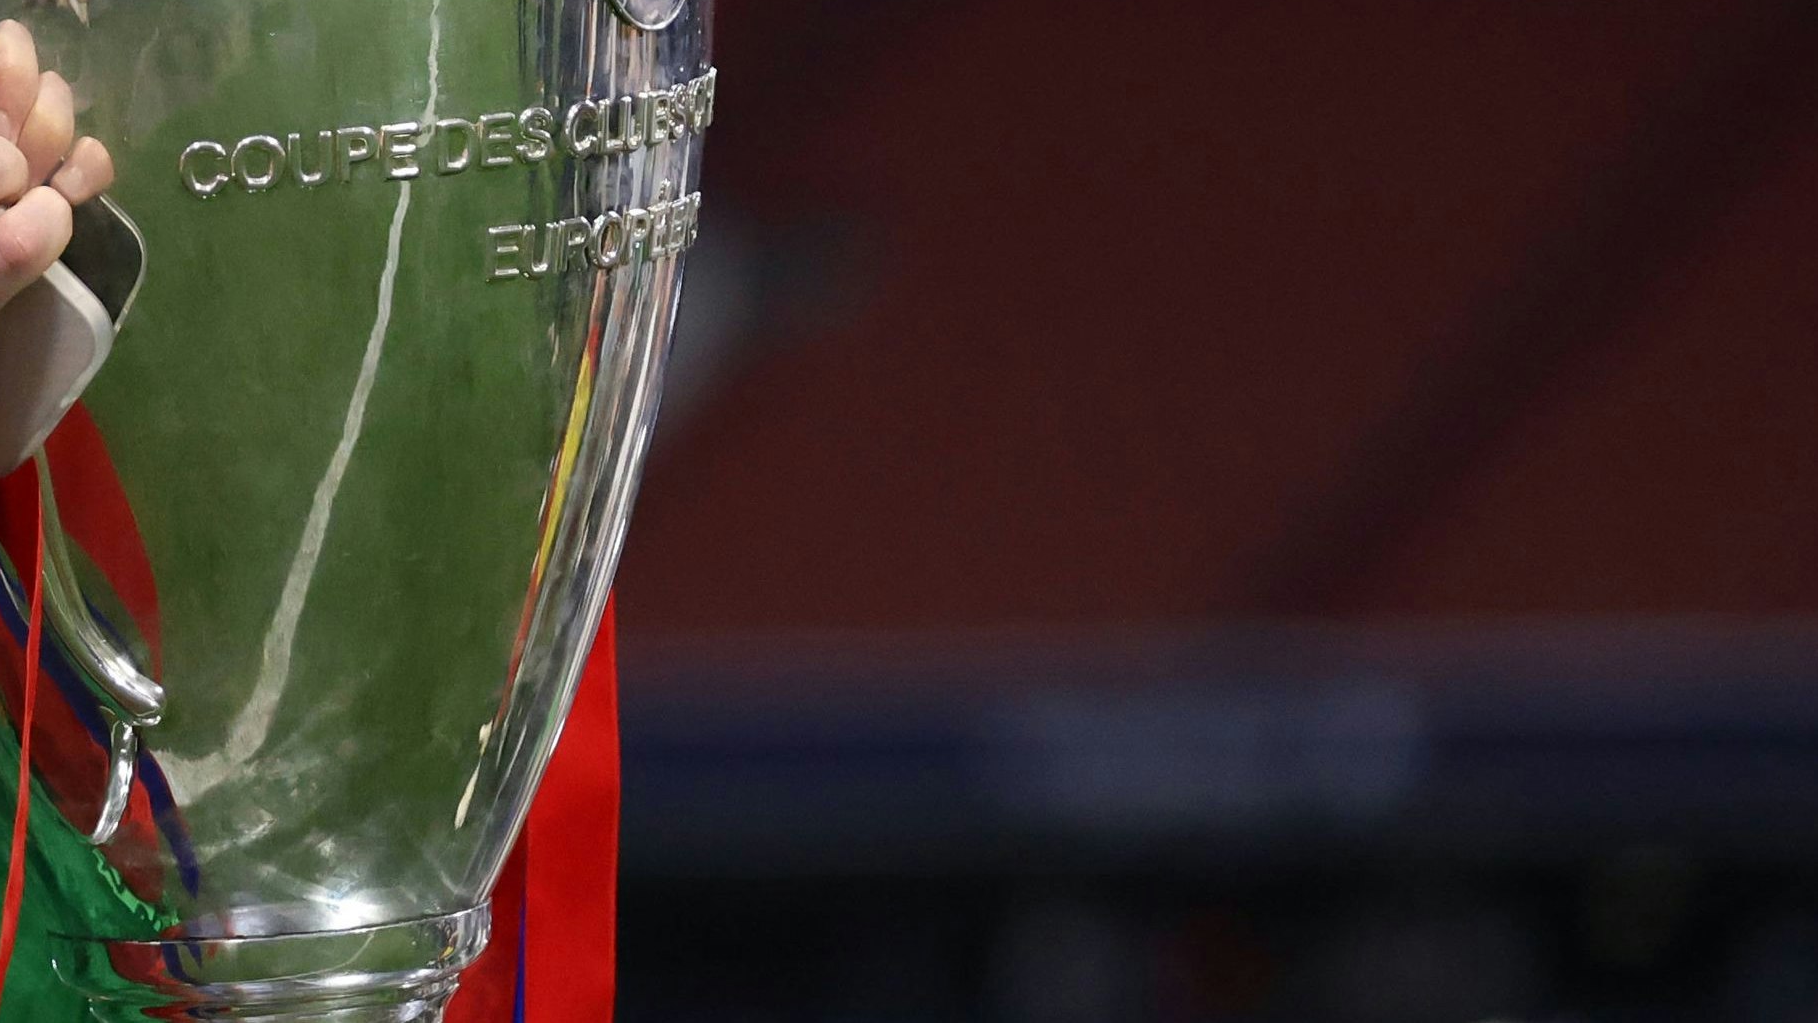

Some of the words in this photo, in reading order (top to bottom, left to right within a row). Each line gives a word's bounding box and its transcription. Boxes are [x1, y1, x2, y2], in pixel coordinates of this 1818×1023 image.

[180, 120, 421, 199] COUPE
[434, 106, 555, 176] DES
[563, 82, 687, 159] CLUBS
